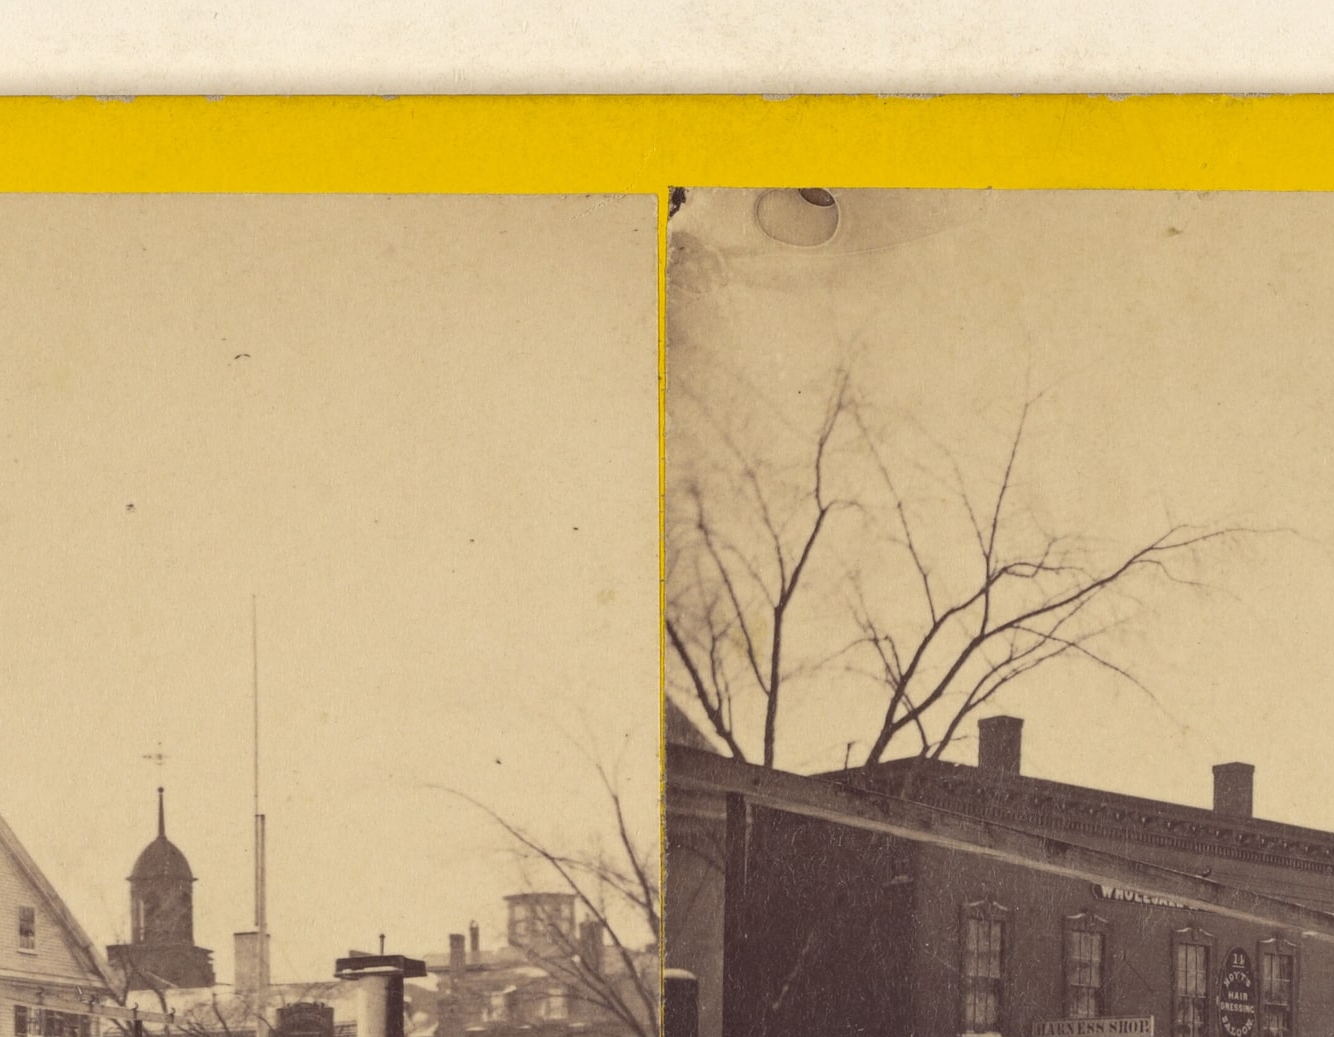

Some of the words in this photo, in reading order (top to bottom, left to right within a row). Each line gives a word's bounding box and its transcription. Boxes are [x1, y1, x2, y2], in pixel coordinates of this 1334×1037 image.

[1227, 991, 1248, 1001] HAIR
[1220, 1001, 1255, 1014] DRESSING
[1037, 1021, 1104, 1036] HARNESS
